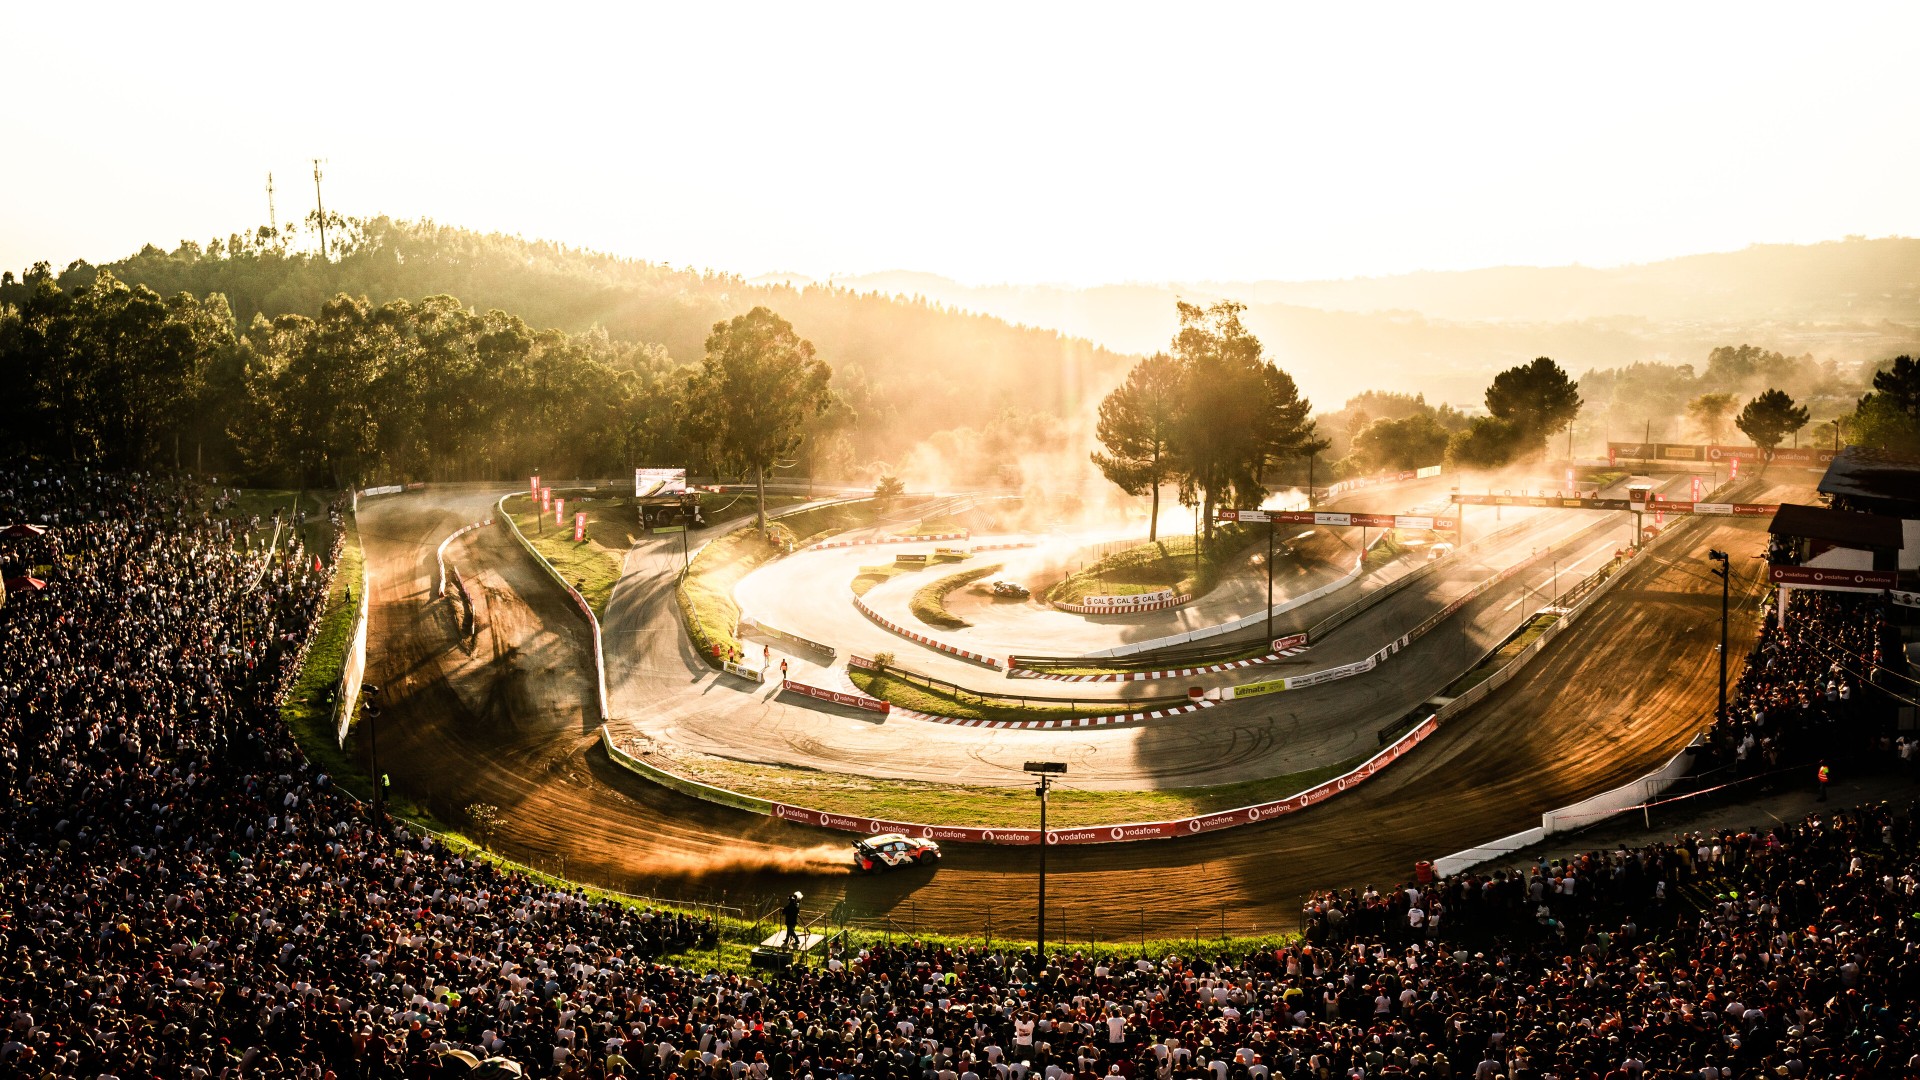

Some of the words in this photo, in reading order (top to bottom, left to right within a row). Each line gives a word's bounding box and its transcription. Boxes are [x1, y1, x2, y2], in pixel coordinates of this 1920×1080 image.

[1437, 520, 1452, 528] acp
[1236, 685, 1266, 696] ultimate
[1308, 788, 1330, 801] vodafone
[785, 810, 809, 819] vodafone
[1260, 804, 1291, 816] vodafone
[830, 818, 857, 828] vodafone
[1201, 816, 1233, 827] vodafone
[881, 825, 910, 834] vodafone
[1125, 827, 1161, 836] vodafone
[934, 830, 966, 839] vodafone
[995, 833, 1029, 841] vodafone
[1060, 832, 1095, 841] vodafone
